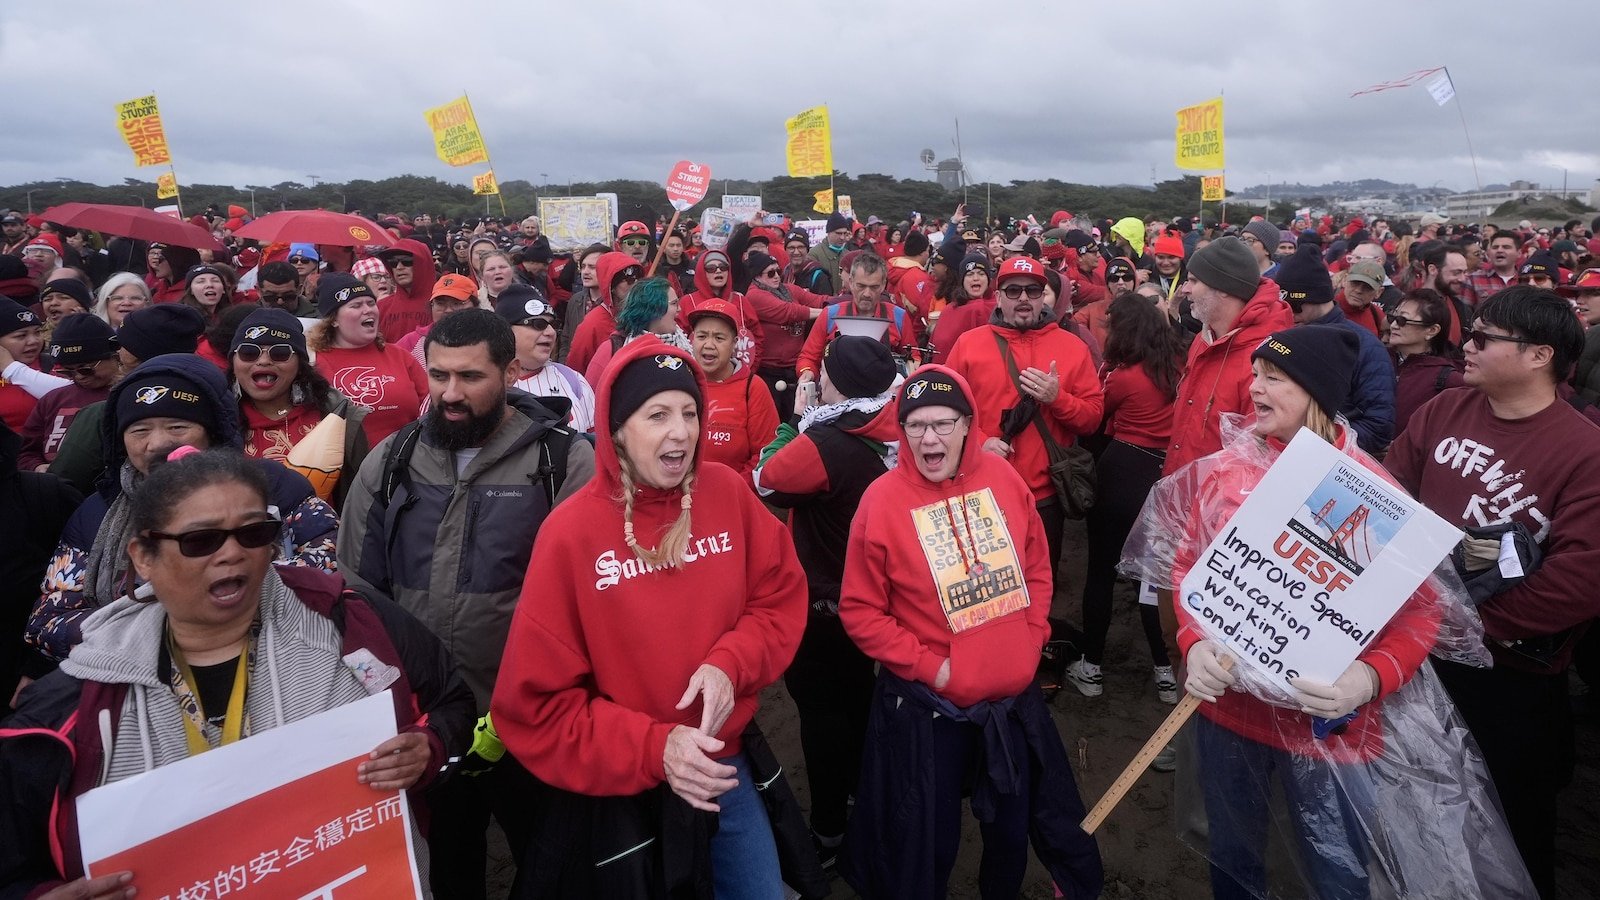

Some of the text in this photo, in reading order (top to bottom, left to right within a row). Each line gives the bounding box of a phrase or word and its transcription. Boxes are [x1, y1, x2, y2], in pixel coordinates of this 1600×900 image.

[688, 164, 701, 173] ON
[677, 171, 704, 184] STRIKE
[270, 329, 291, 340] UESF
[63, 345, 83, 353] UESF
[1268, 339, 1292, 356] UESF
[931, 382, 953, 392] UESF
[172, 390, 200, 403] UESF
[707, 430, 731, 442] 1493
[1334, 475, 1400, 521] OF SAN FRANCISCO
[1338, 466, 1408, 516] UNITED EDUCATORS
[1273, 531, 1354, 593] UESF
[1206, 549, 1311, 641] Education
[1223, 526, 1375, 647] Improve Special
[1204, 576, 1289, 655] Working
[156, 795, 403, 900] 校的安全穩定而
